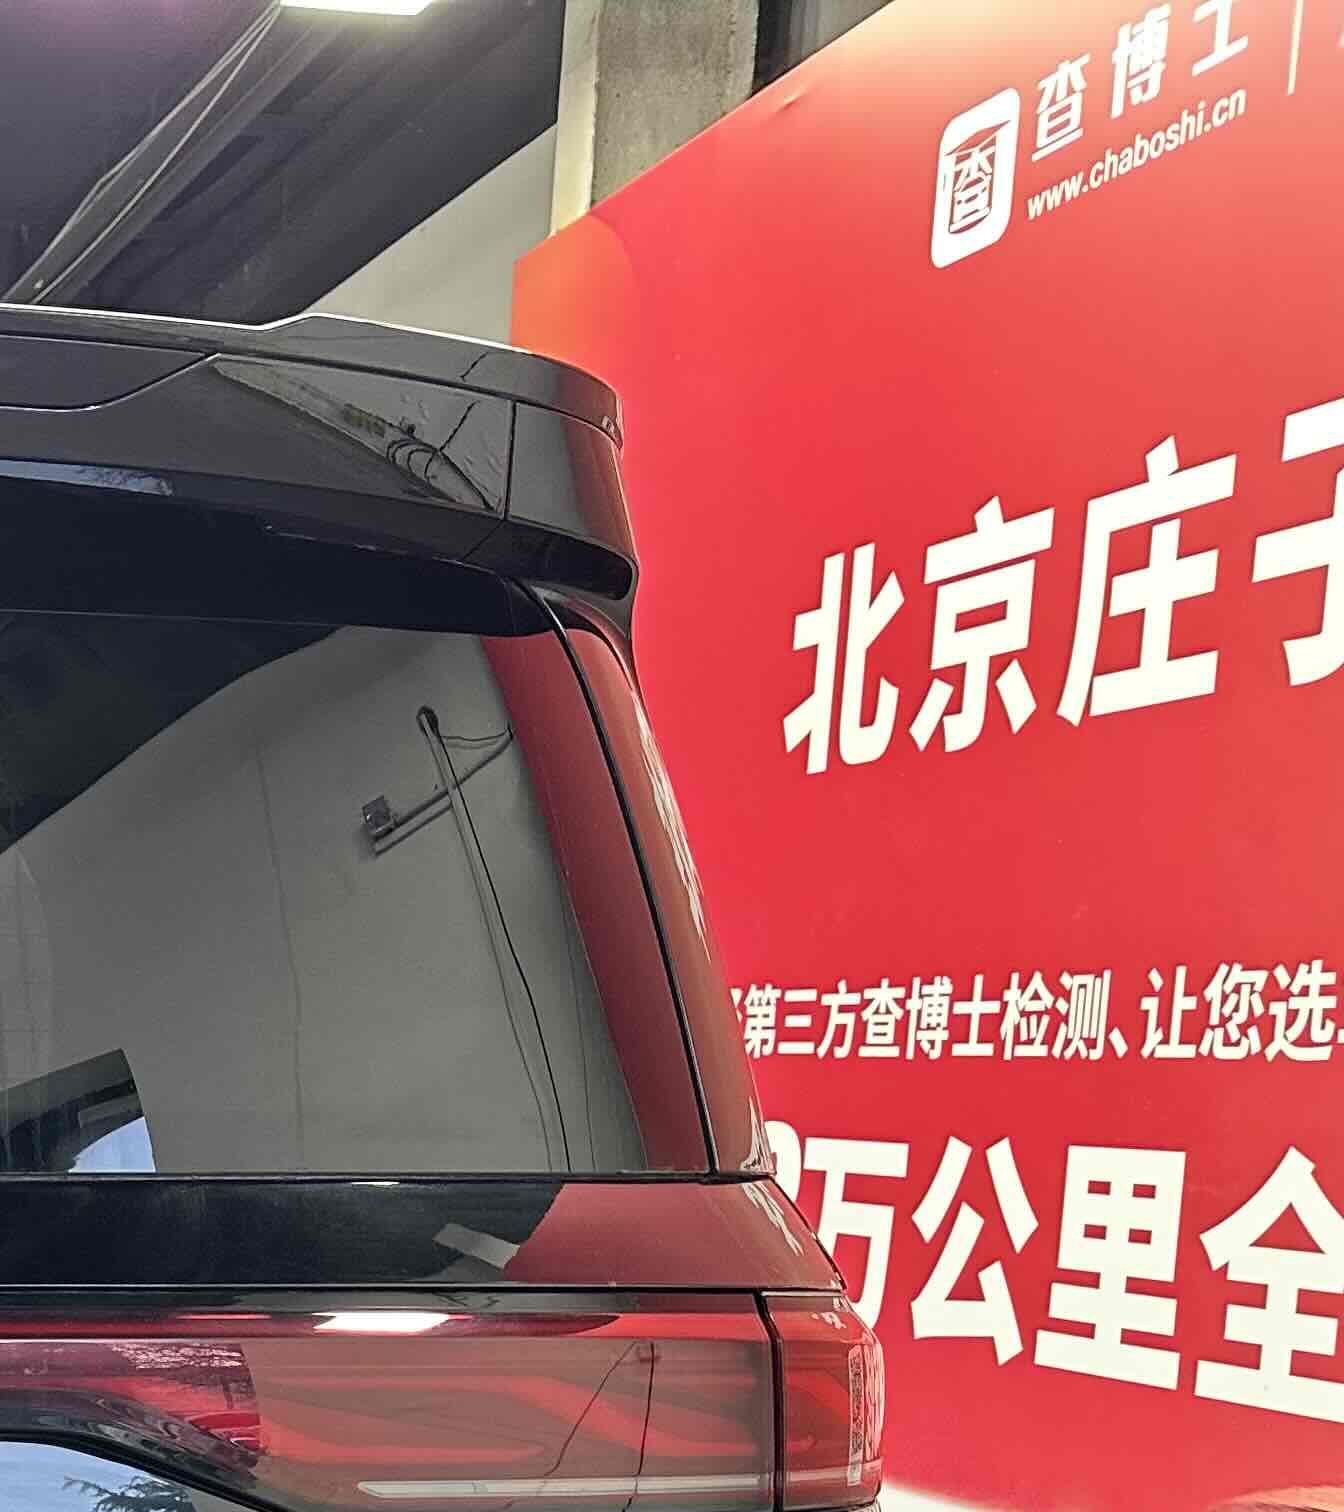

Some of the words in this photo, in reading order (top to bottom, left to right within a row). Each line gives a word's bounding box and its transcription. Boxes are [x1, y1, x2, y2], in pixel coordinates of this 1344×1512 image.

[1027, 88, 1248, 220] www.chaboshi.cn
[730, 959, 1344, 1062] 第三方查博士检测、让您选
